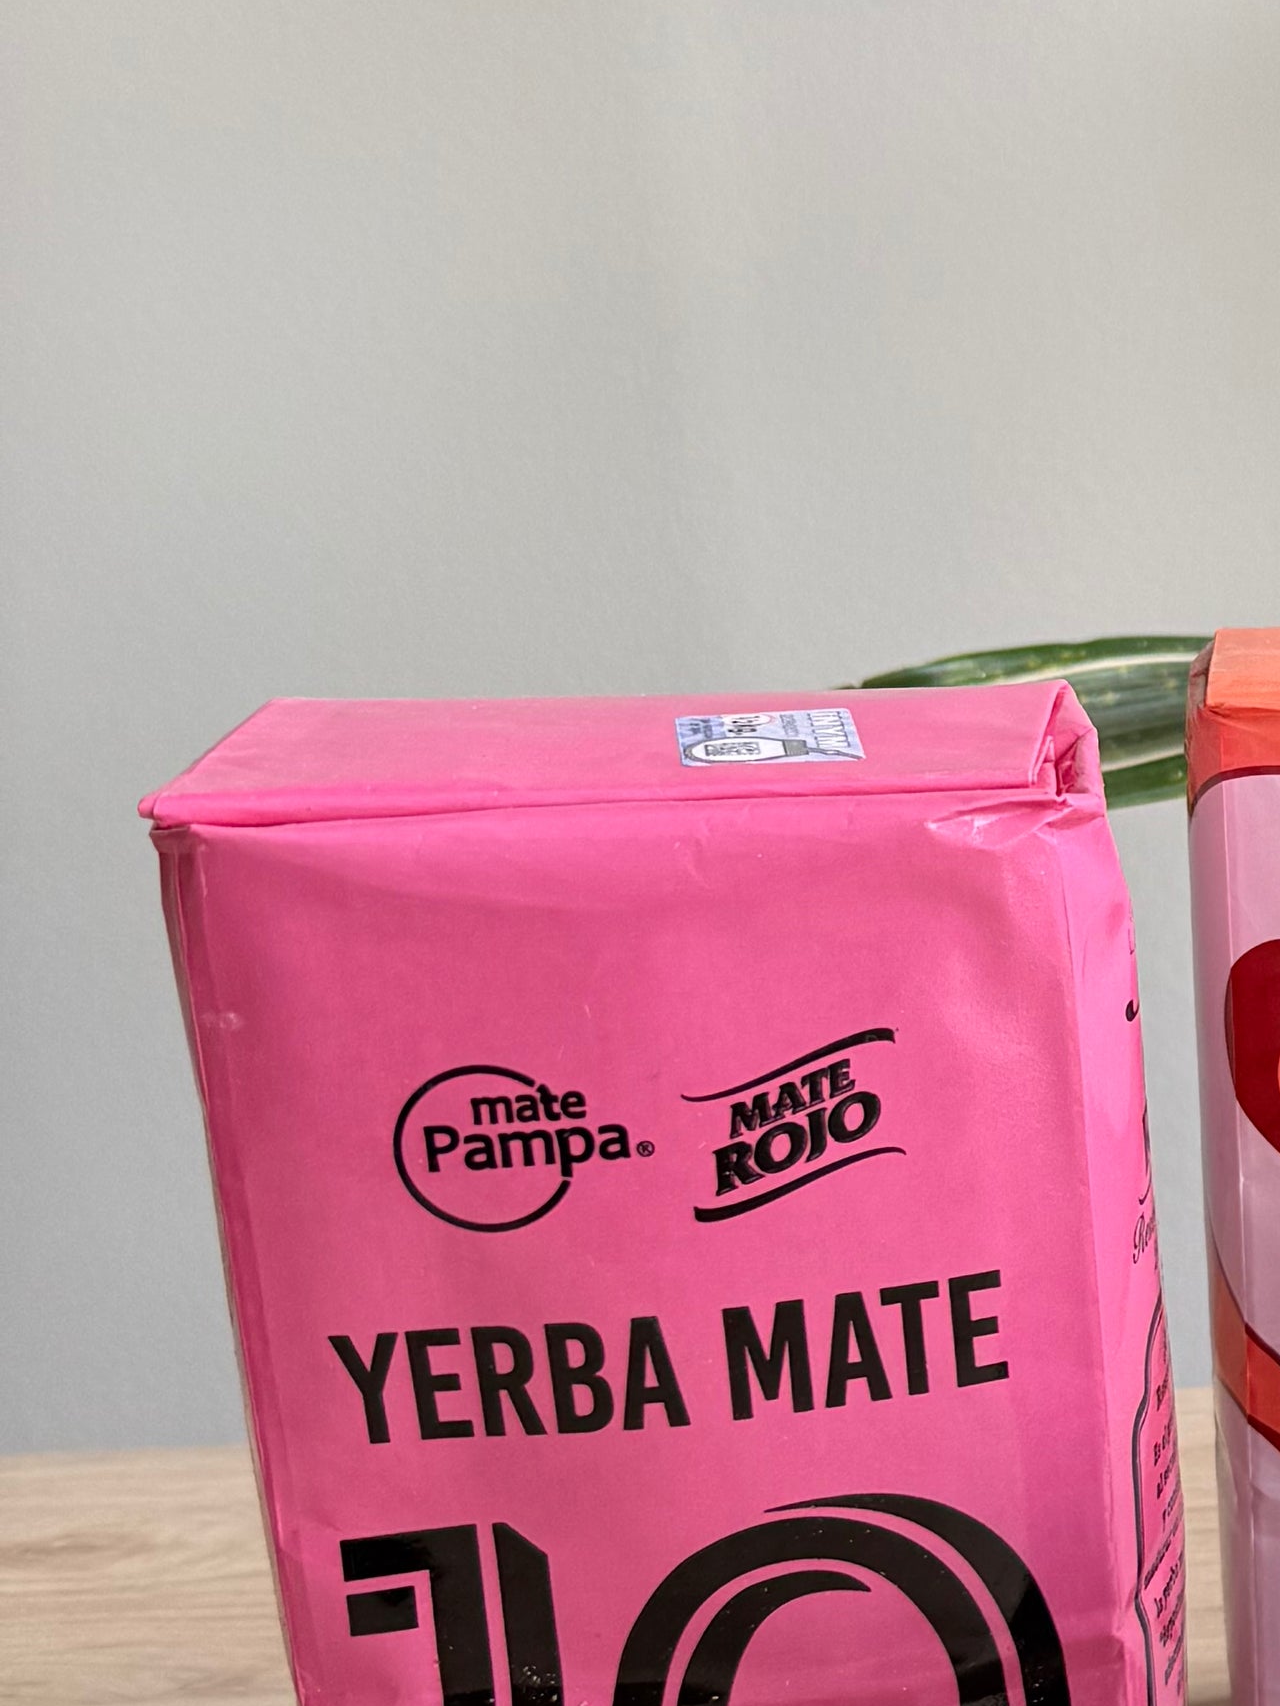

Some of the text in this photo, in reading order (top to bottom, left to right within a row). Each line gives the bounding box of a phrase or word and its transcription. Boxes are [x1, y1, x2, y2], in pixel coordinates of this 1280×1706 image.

[470, 1084, 587, 1125] mate
[712, 1091, 882, 1196] ROJO
[729, 1058, 856, 1140] MATE
[327, 1270, 1010, 1445] YERBA MATE
